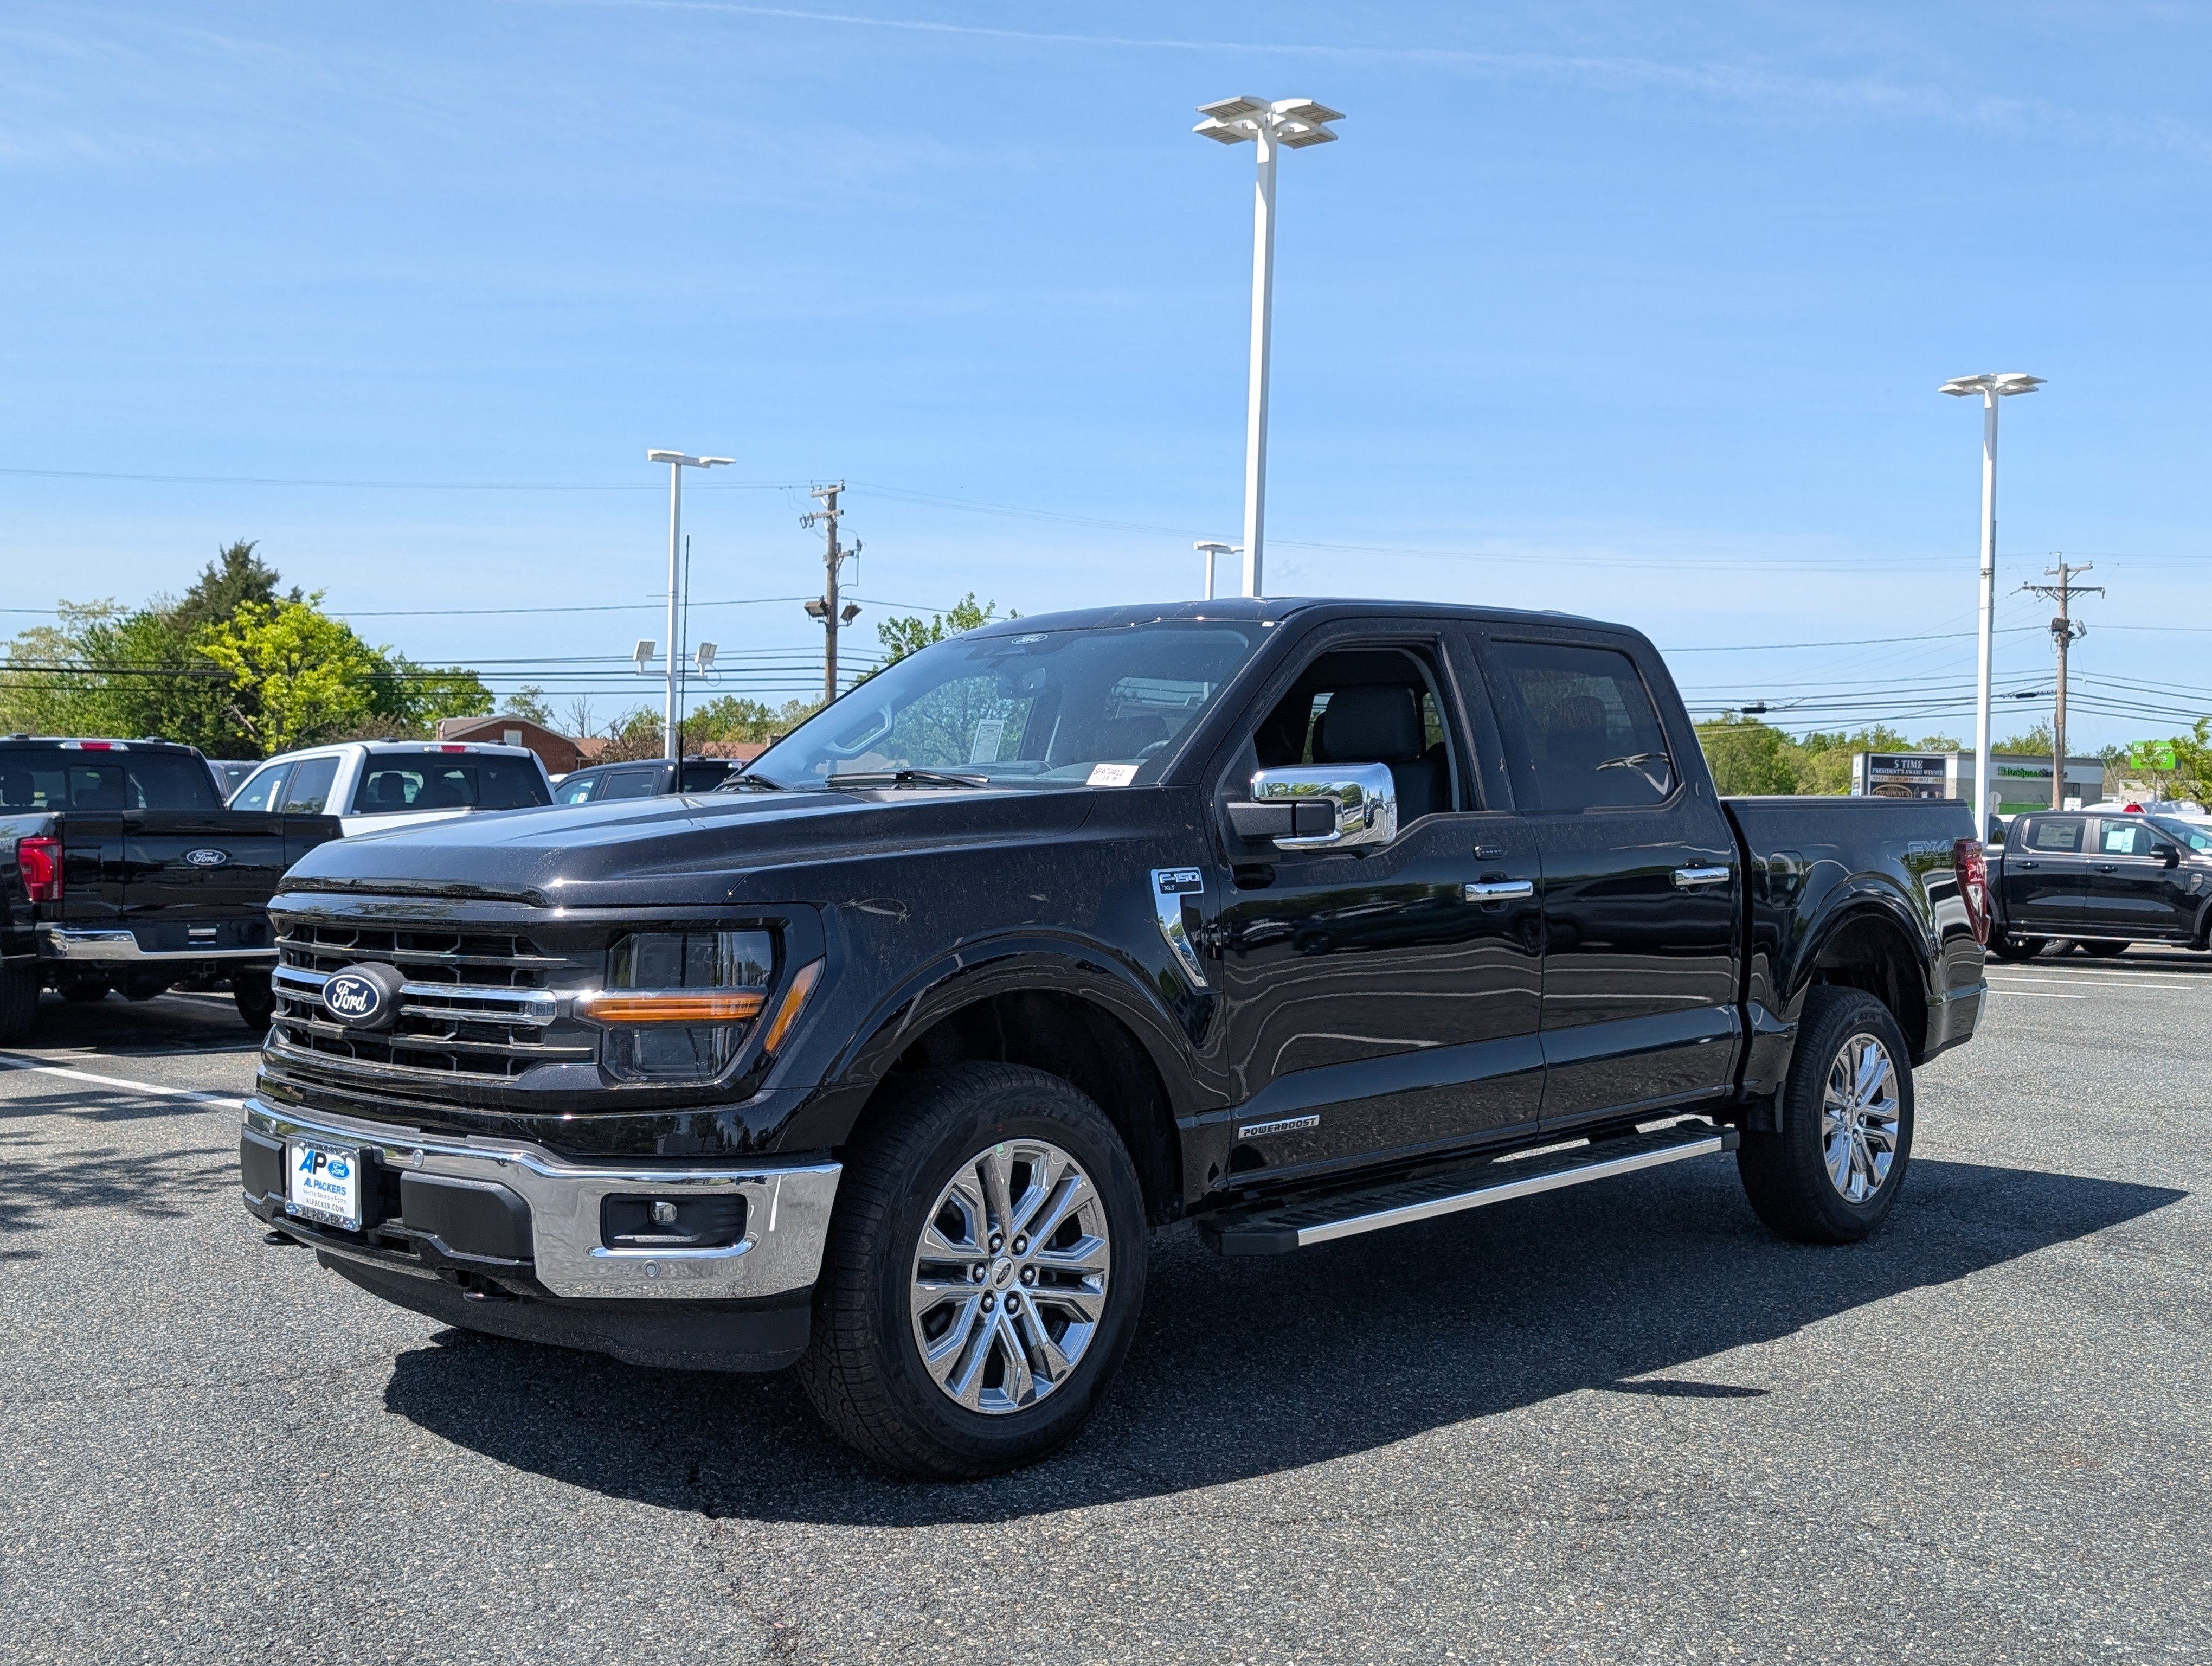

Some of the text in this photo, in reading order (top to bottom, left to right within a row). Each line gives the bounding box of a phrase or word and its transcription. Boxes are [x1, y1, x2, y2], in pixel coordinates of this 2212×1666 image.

[1894, 759, 1924, 770] 5 TIME
[194, 852, 219, 862] Ford
[1907, 840, 1952, 867] FX4
[1159, 872, 1200, 883] F-150
[332, 980, 368, 1011] Ford
[1244, 1118, 1316, 1136] POWERBOOST
[299, 1149, 327, 1175] AP
[304, 1177, 312, 1188] AL
[303, 1188, 347, 1204] WHITE MARSH FORD
[306, 1197, 344, 1213] ALPACKER.COM
[302, 1207, 311, 1218] AL
[312, 1209, 340, 1226] PACKER
